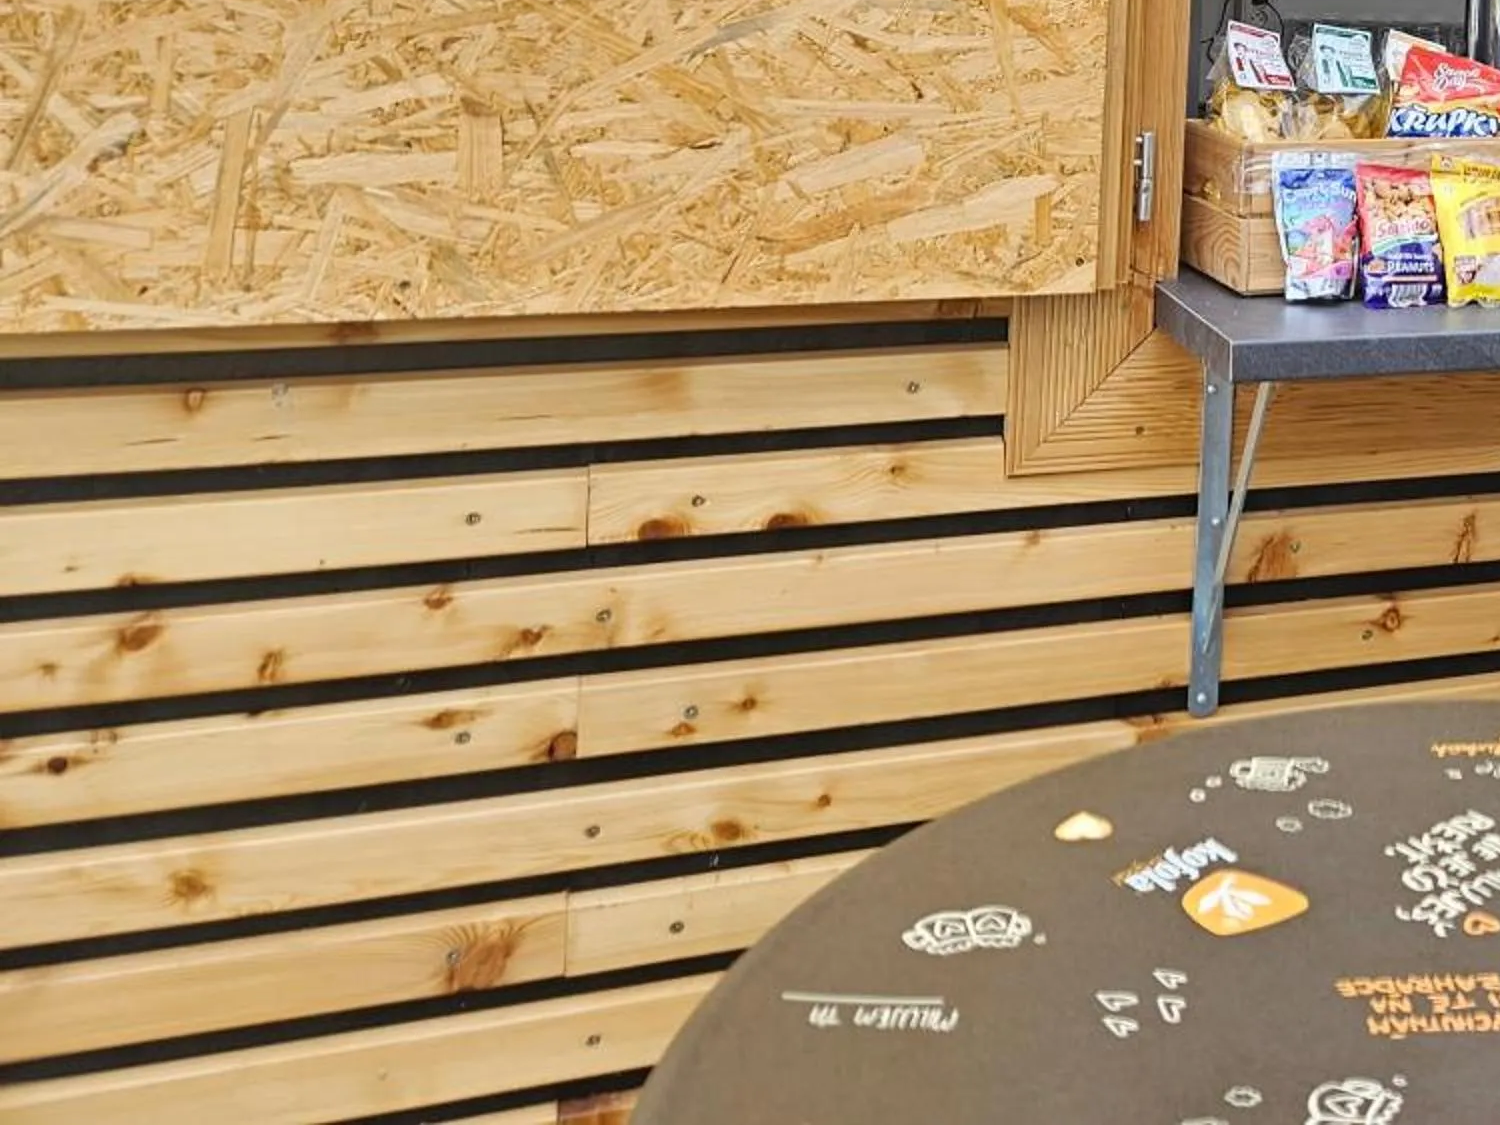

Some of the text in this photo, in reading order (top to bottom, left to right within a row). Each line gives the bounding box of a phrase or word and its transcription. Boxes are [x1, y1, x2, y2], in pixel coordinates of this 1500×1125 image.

[1387, 261, 1434, 274] PEANUTS
[1124, 837, 1238, 892] kofola
[1369, 997, 1412, 1014] NA
